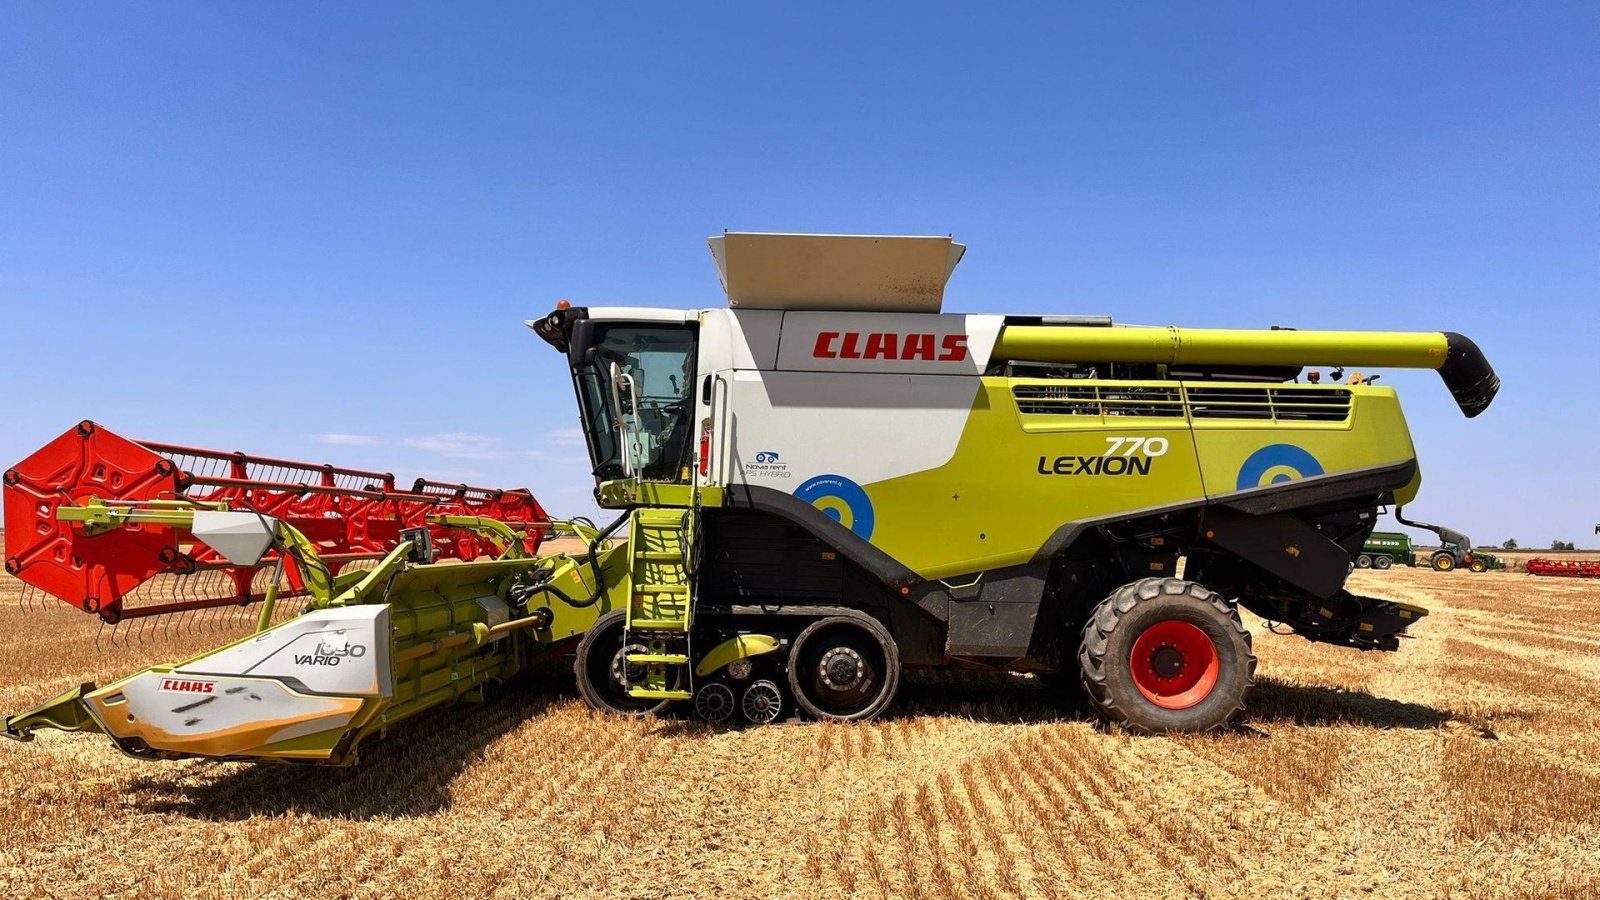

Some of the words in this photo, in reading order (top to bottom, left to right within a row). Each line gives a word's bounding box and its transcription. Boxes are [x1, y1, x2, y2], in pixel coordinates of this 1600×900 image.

[813, 332, 968, 361] CLAAS
[1103, 437, 1168, 457] 770
[1038, 456, 1152, 475] LEXION
[294, 655, 340, 666] VARIO
[163, 680, 214, 693] CLAAS
